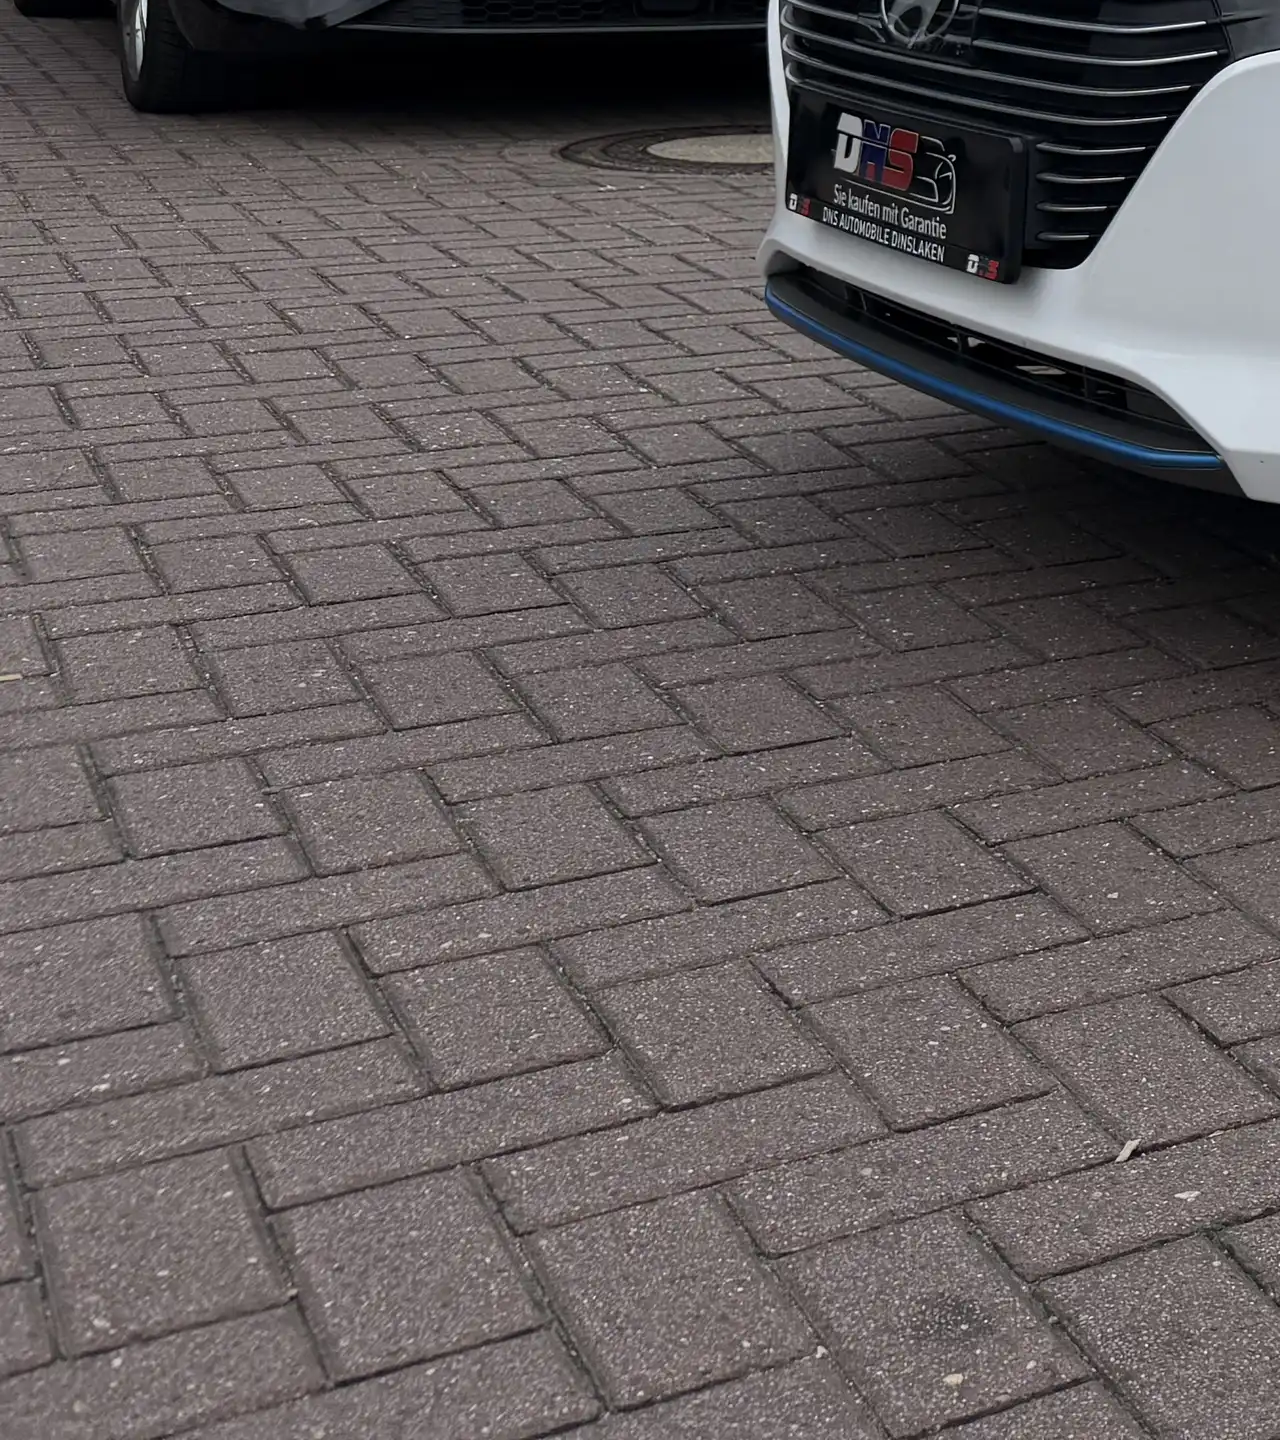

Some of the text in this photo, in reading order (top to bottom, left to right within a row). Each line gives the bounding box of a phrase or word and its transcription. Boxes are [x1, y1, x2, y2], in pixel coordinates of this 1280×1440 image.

[833, 112, 919, 192] DNS
[822, 206, 945, 262] DNS AUTOMOBILE DINSLAKEN
[833, 183, 947, 240] Sie kaufen mit Garantie
